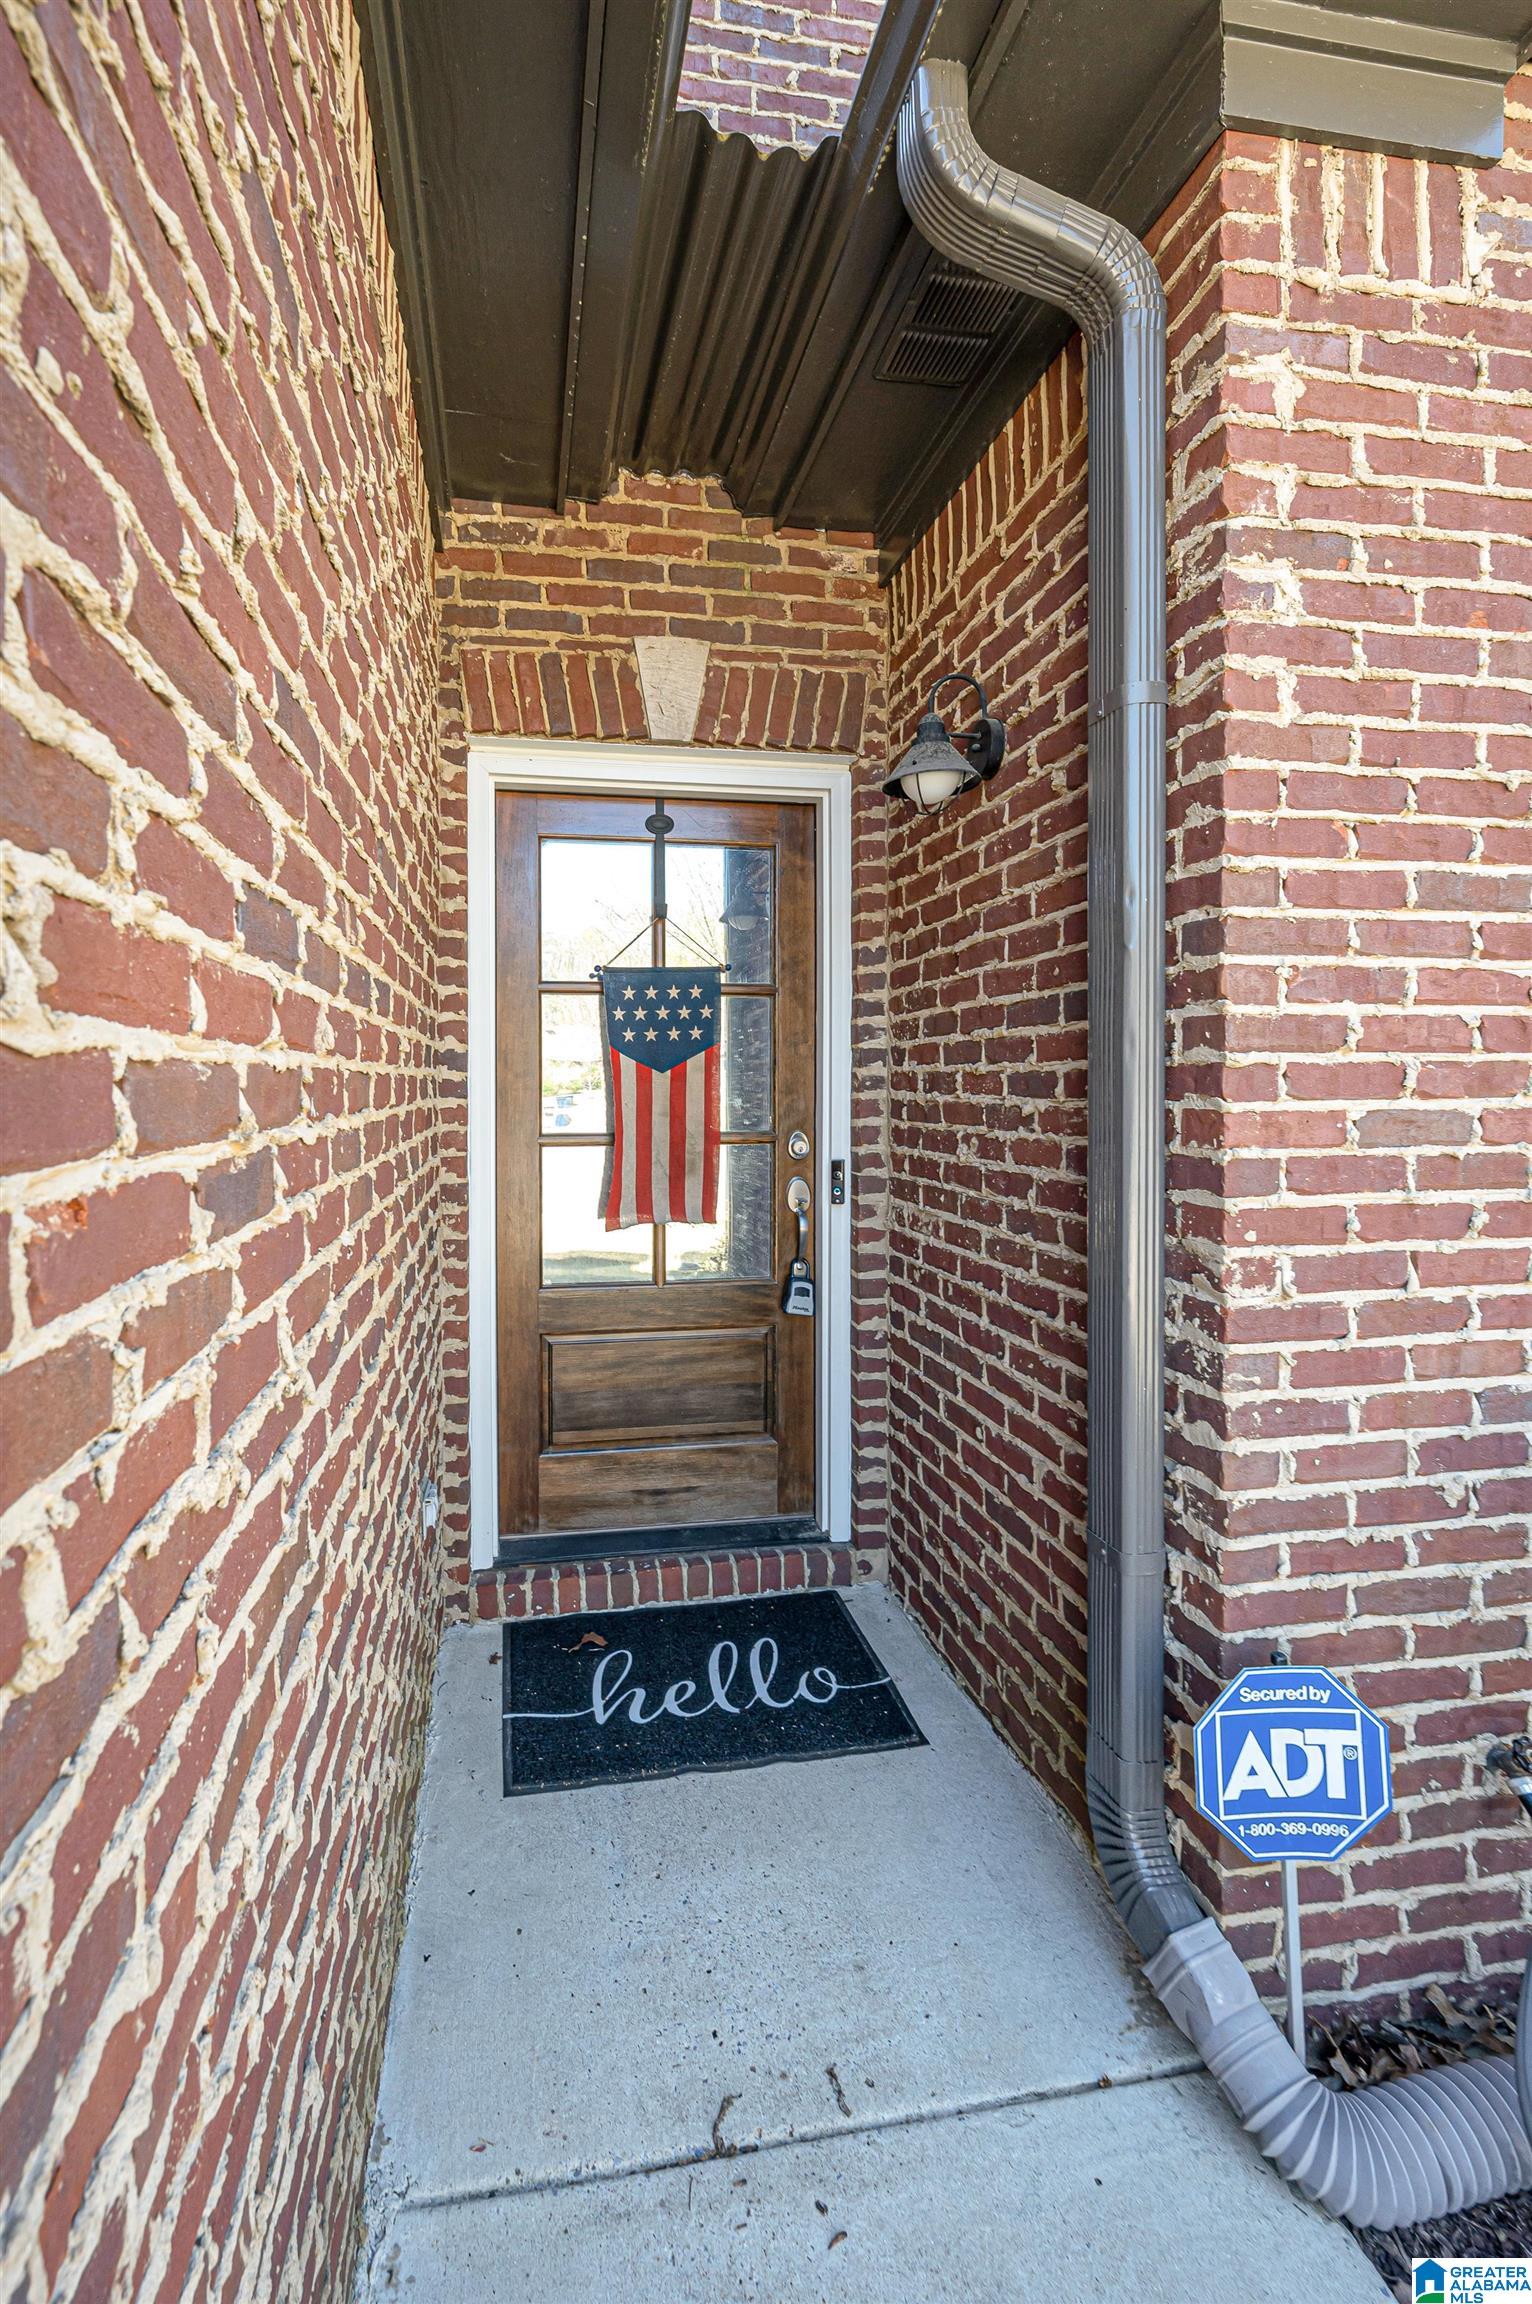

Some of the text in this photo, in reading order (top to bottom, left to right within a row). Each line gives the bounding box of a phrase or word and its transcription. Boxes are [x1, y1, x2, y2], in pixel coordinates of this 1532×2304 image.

[592, 1637, 840, 1725] hello
[1239, 1685, 1331, 1704] Secured by
[1223, 1728, 1361, 1801] ADT
[1238, 1822, 1349, 1838] 1-800-369-0996
